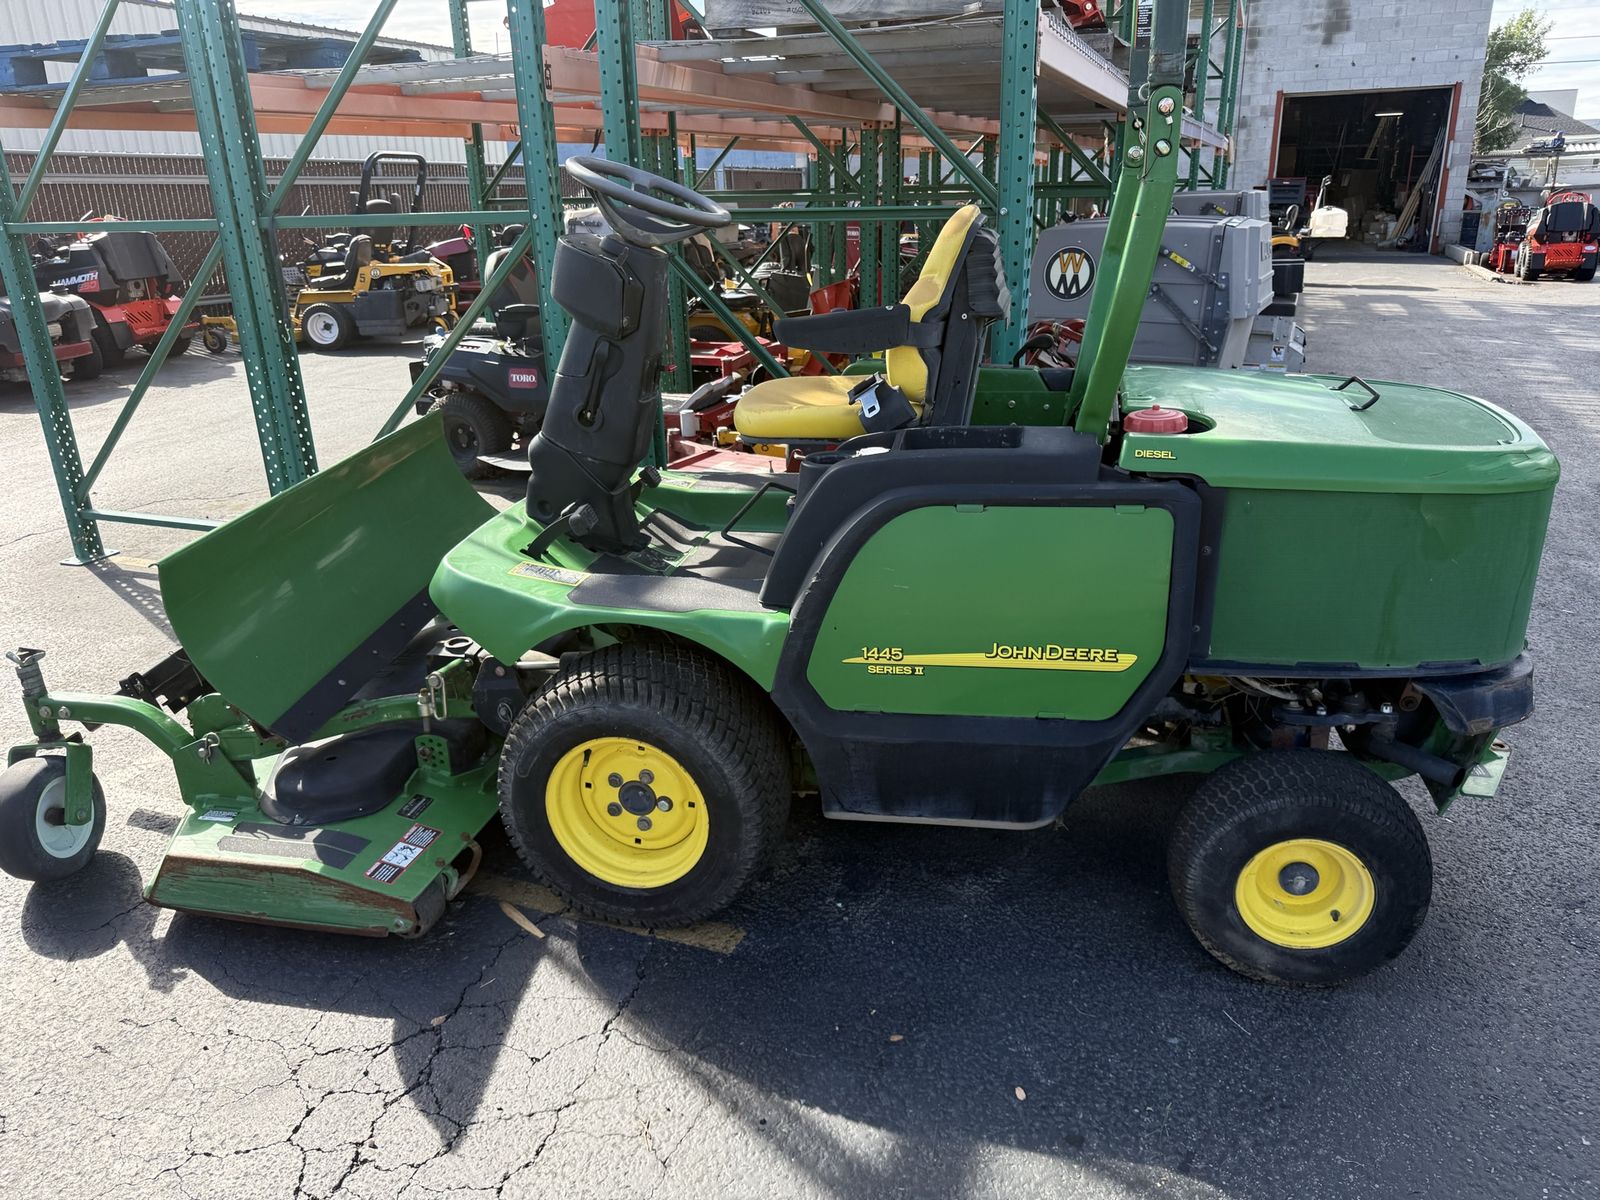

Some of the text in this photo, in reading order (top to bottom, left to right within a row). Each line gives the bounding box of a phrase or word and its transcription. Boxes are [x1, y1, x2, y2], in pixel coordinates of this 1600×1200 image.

[511, 373, 536, 383] TORO
[1135, 449, 1177, 460] DIESEL
[861, 642, 1119, 662] 1445 JOHN DEERE
[867, 664, 924, 676] SERIES II
